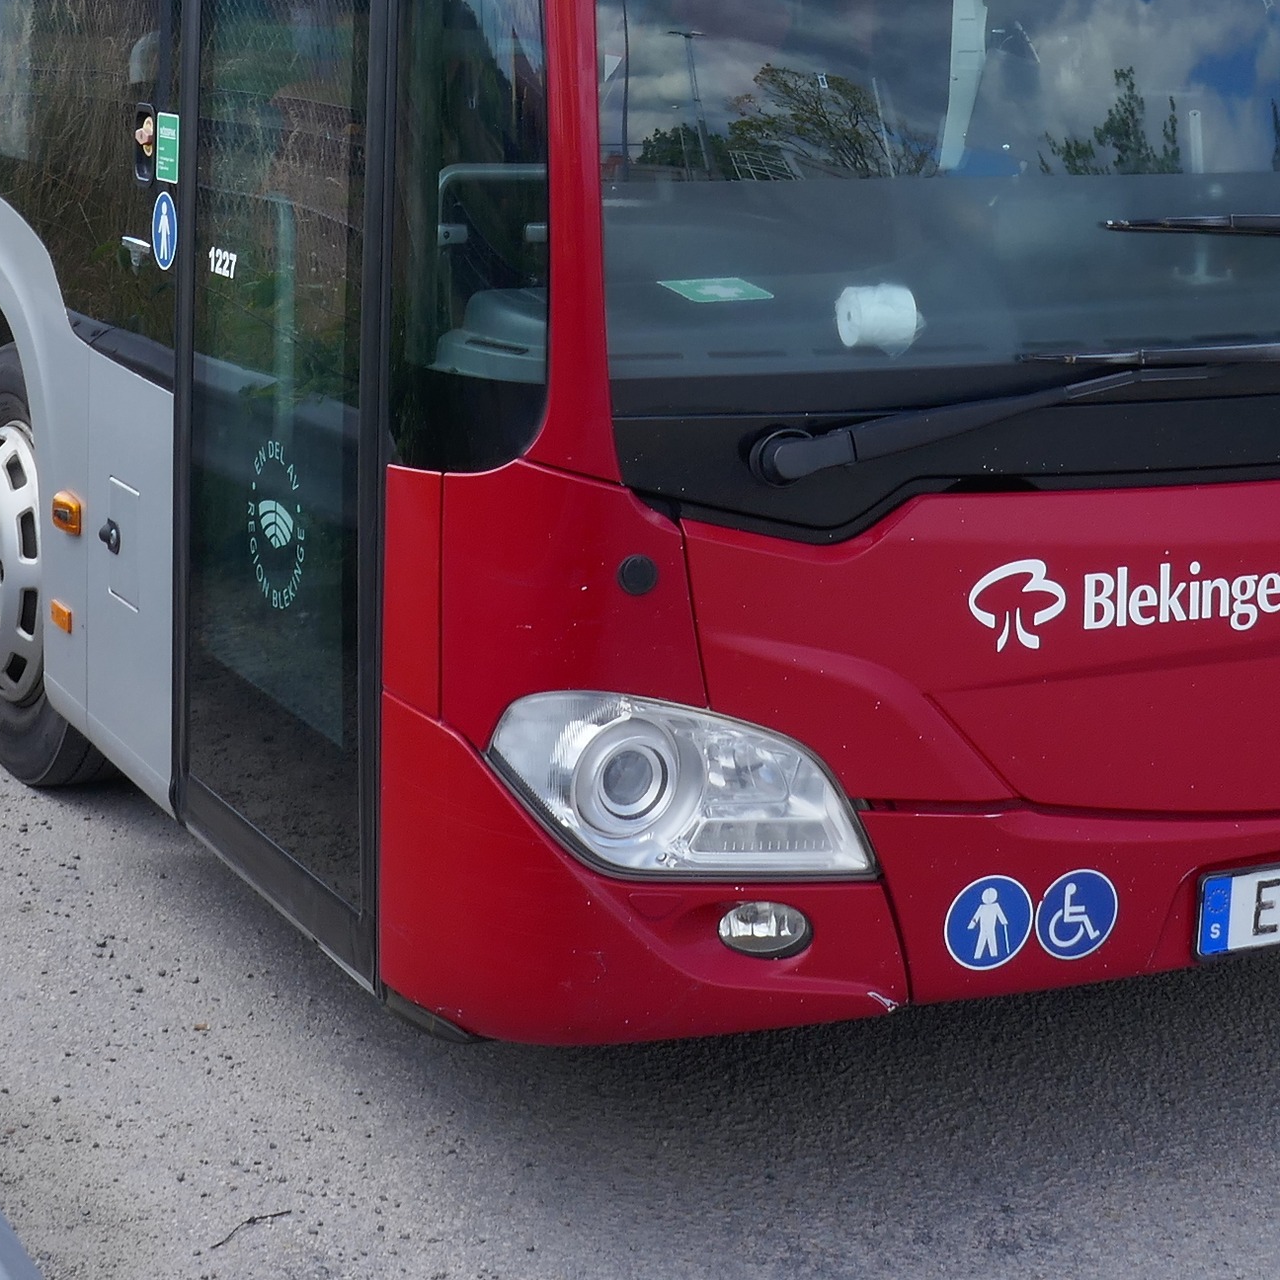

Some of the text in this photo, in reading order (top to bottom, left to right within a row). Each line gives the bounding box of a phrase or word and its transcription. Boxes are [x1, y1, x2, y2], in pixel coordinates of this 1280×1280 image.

[208, 246, 238, 280] 1227
[254, 440, 300, 491] EN DEL AV
[247, 501, 306, 610] REGION BLEKINGE
[1209, 922, 1221, 940] S
